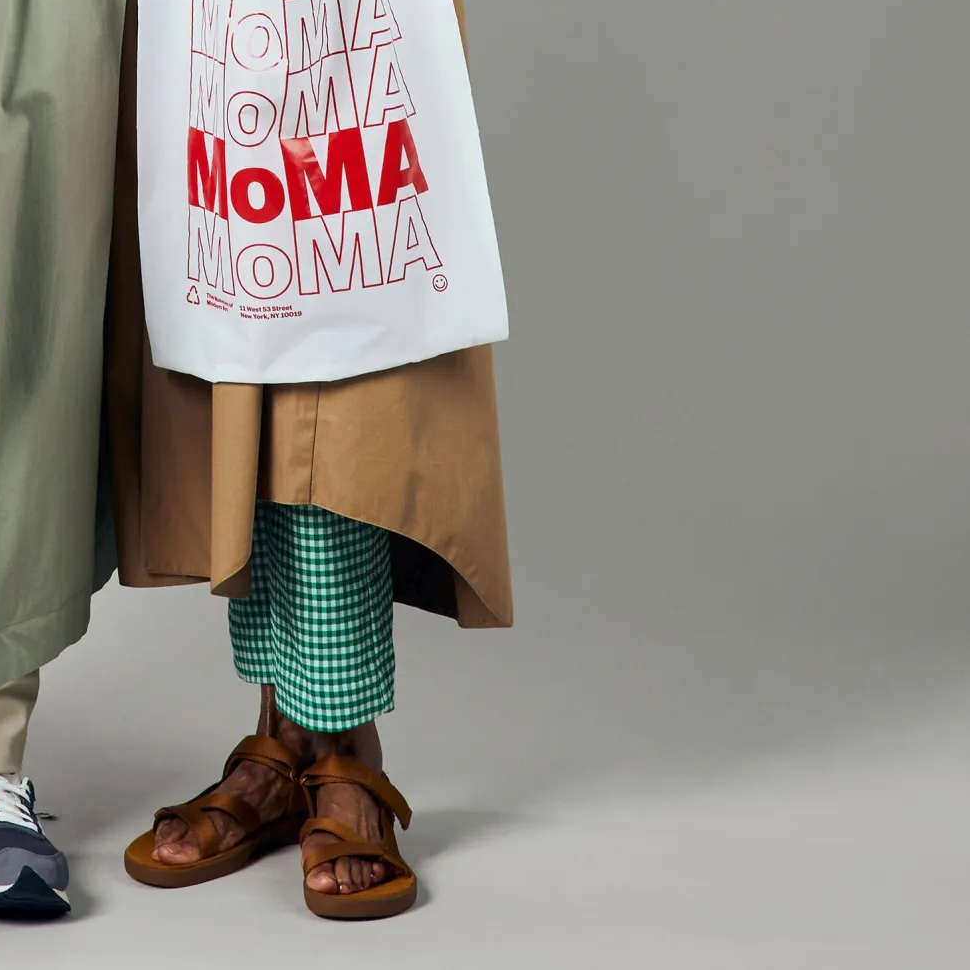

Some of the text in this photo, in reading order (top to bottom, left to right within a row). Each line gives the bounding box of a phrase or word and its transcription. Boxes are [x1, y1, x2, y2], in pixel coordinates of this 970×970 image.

[189, 41, 416, 147] MoMA
[187, 117, 429, 224] MoMA
[187, 194, 443, 300] MoMA
[280, 311, 303, 319] 10019
